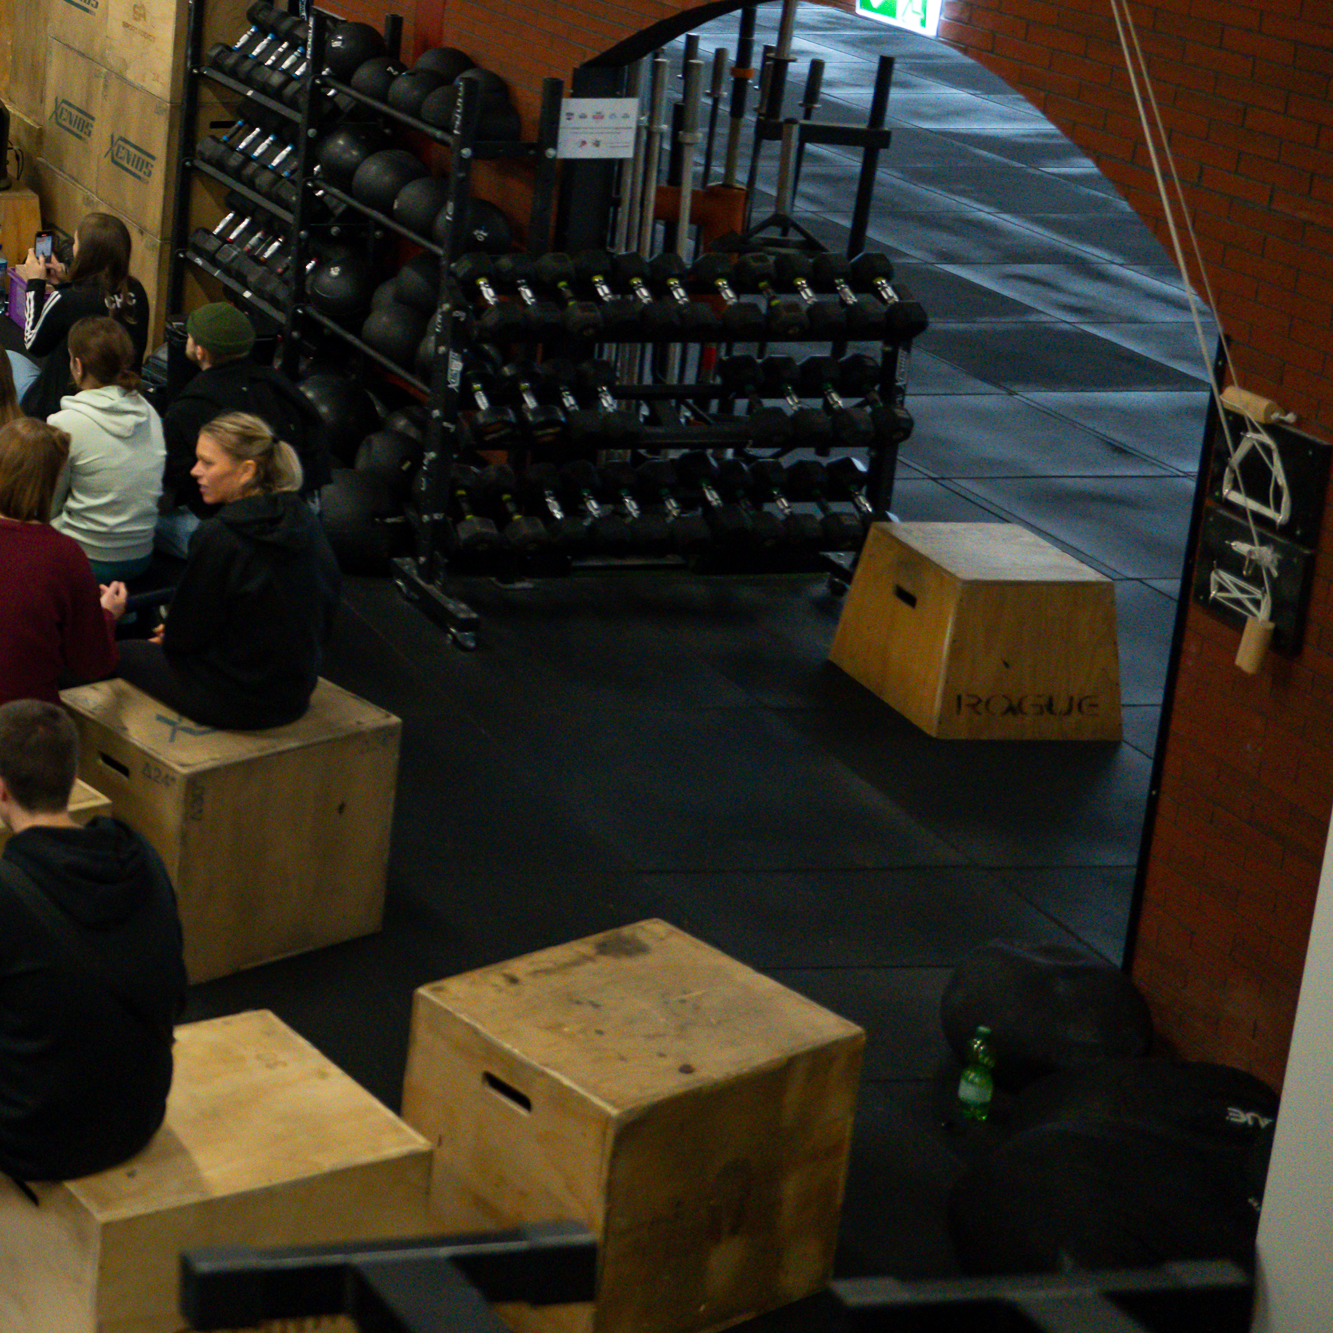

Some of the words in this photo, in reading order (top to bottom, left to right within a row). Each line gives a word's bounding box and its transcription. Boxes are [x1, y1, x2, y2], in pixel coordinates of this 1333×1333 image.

[48, 96, 95, 143] XENIOS
[104, 132, 156, 185] XENIOS
[955, 693, 1100, 717] ROGUE
